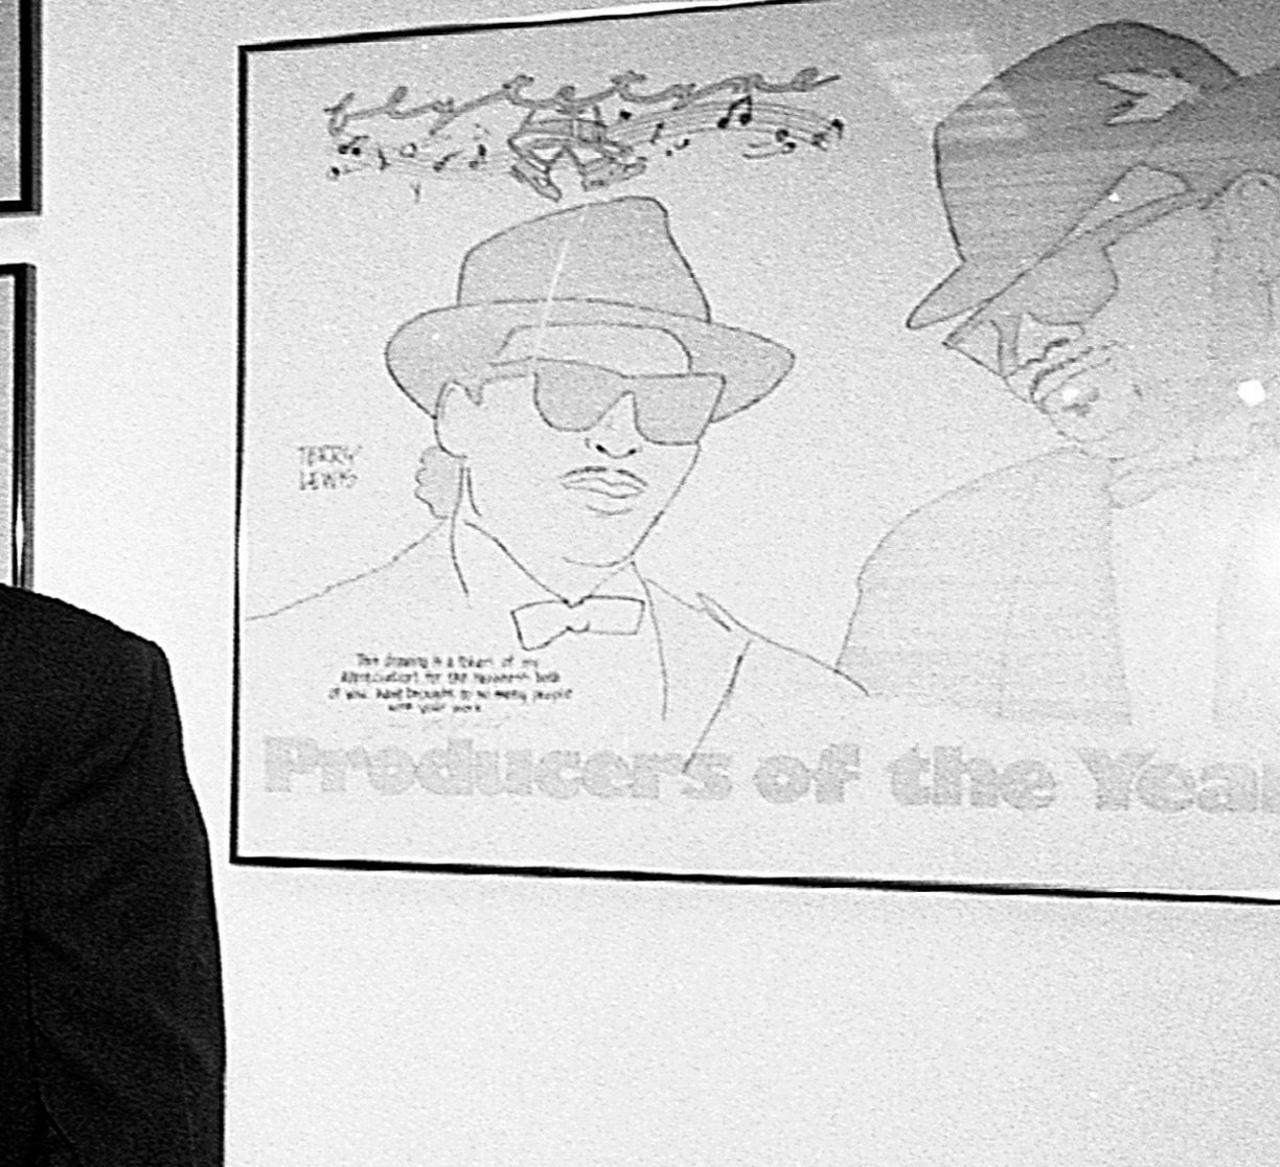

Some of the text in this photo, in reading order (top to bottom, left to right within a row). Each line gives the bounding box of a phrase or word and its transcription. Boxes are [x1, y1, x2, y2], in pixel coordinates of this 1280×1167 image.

[264, 736, 733, 801] Producers
[752, 743, 860, 805] of
[886, 743, 1057, 811] the
